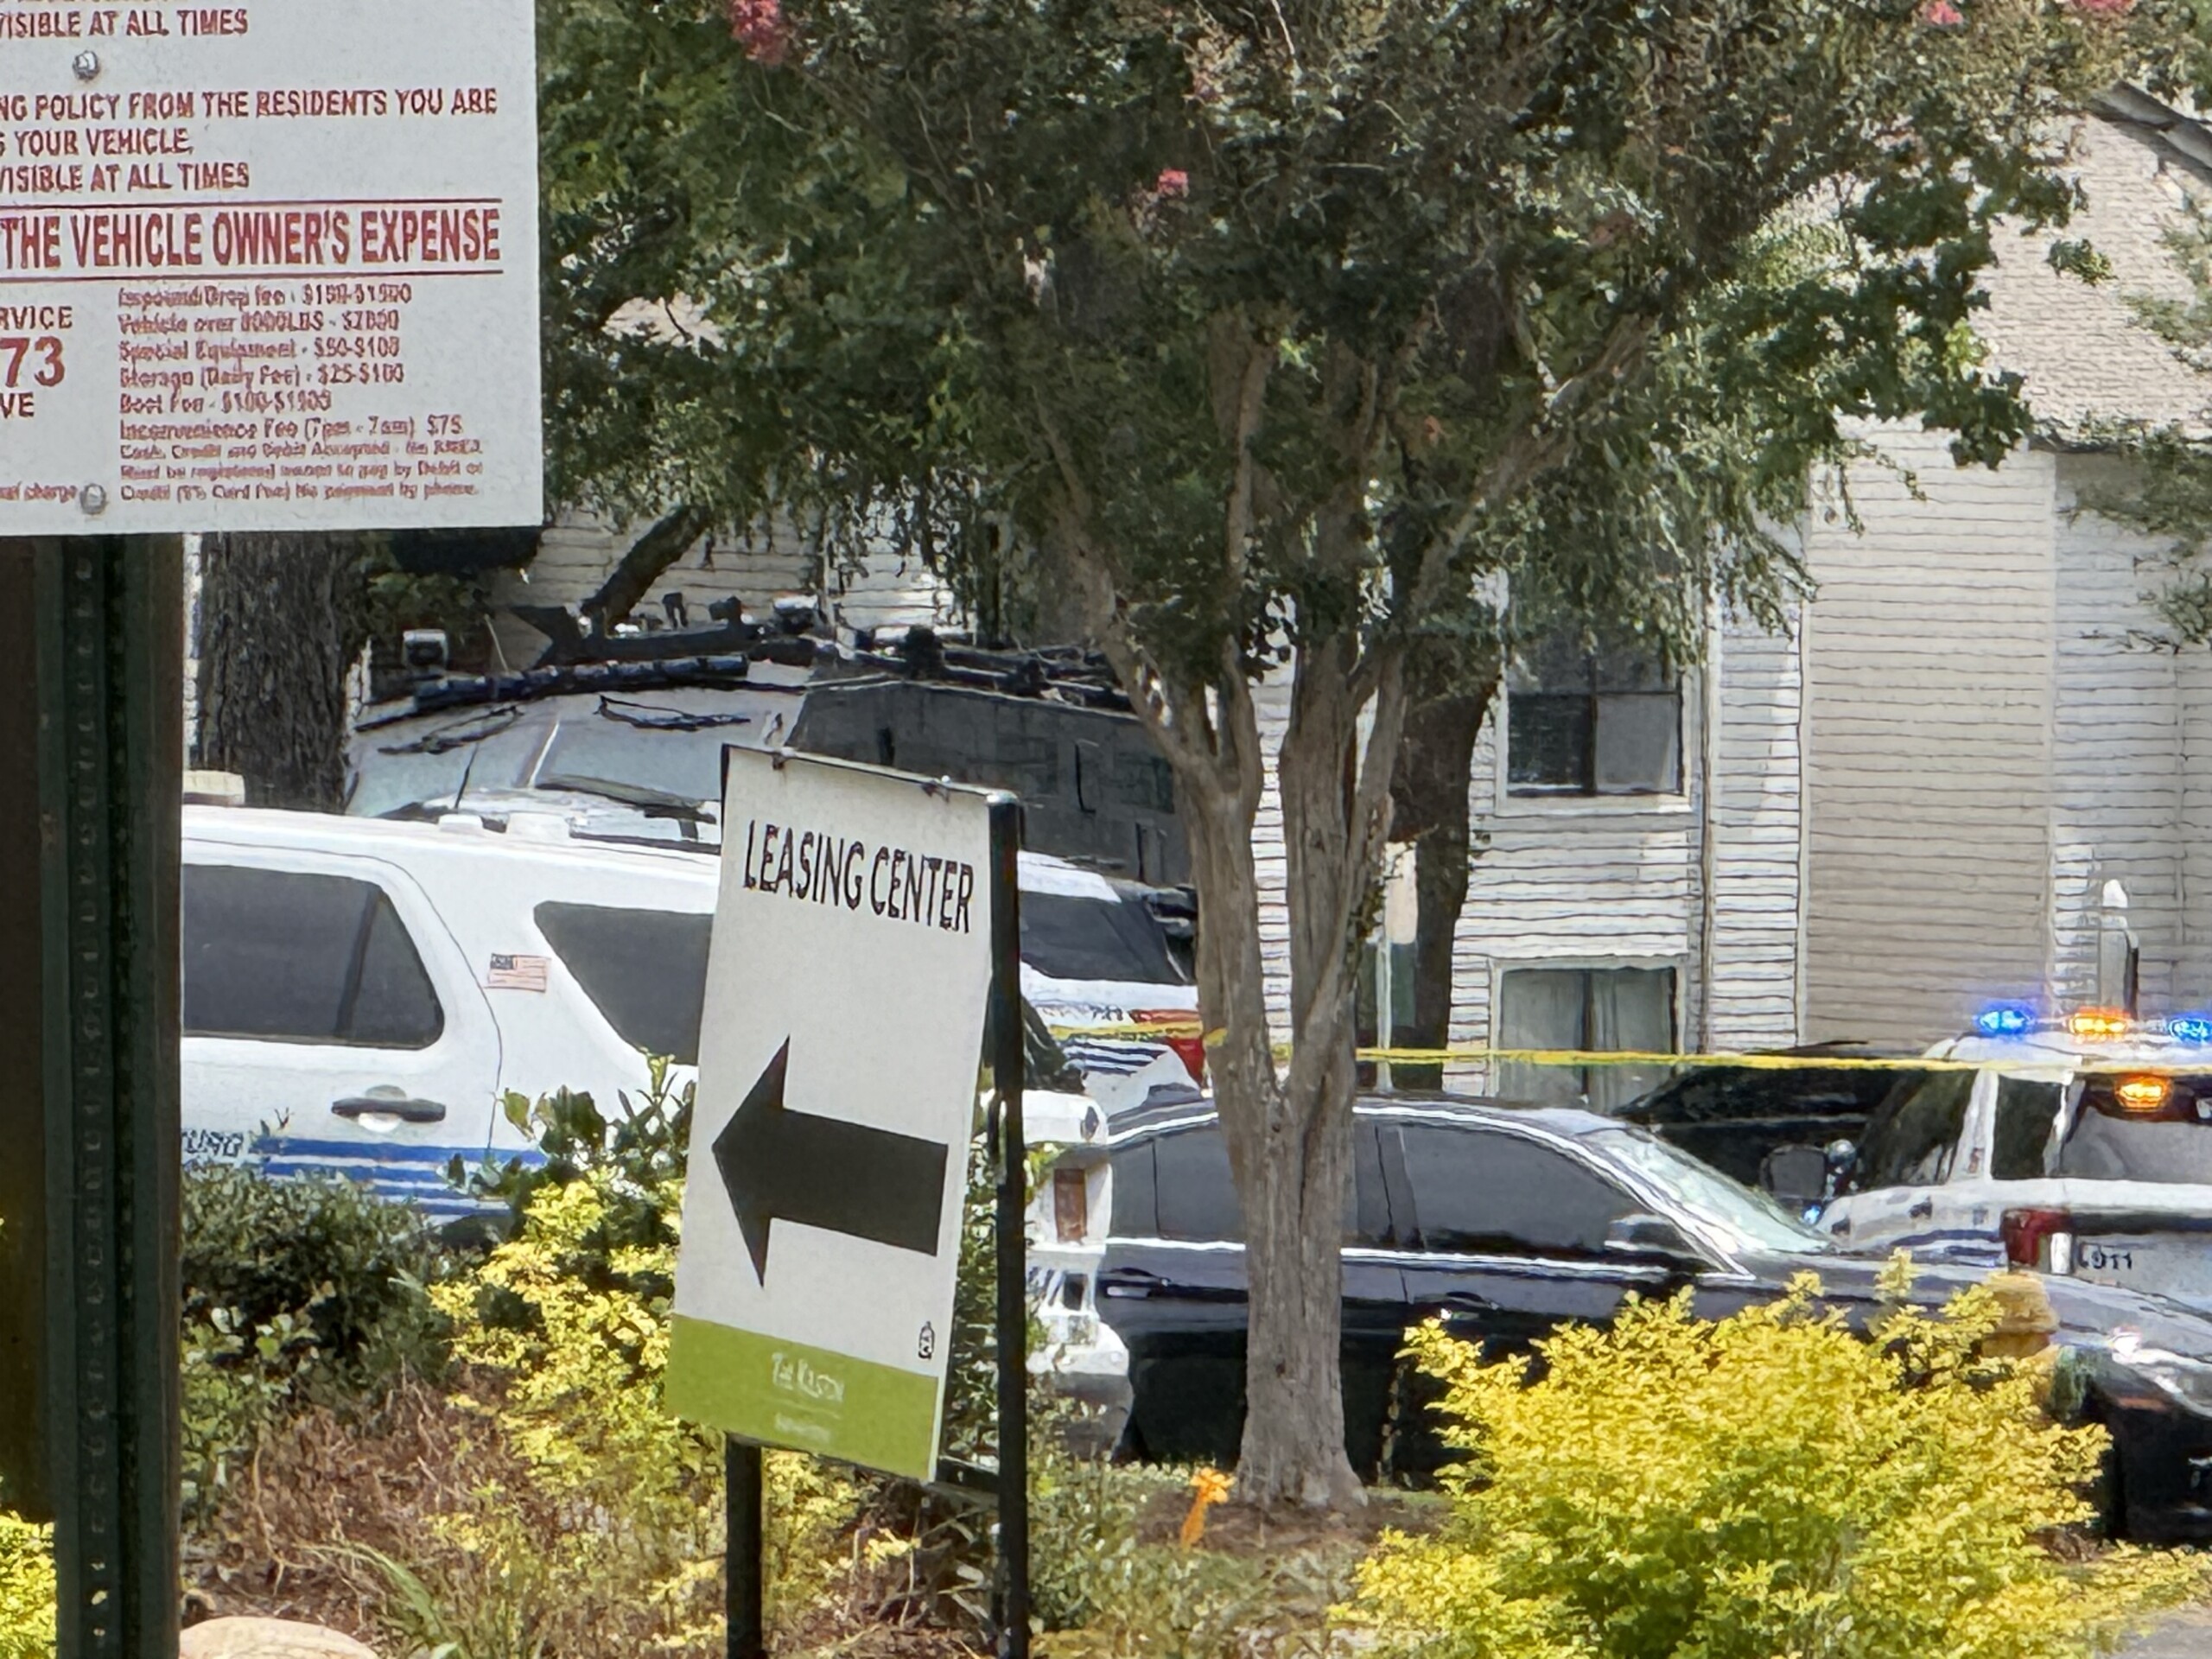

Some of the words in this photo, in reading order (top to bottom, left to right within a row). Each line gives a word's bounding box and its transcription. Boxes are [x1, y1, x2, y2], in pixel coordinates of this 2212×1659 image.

[89, 10, 119, 36] AT
[126, 10, 170, 36] ALL
[177, 9, 249, 36] TIMES
[35, 93, 120, 121] POLICY
[130, 92, 194, 120] FROM
[201, 91, 250, 118] THE
[257, 89, 388, 118] RESIDENTS
[395, 88, 443, 116] YOU
[451, 88, 498, 115] ARE
[14, 129, 79, 157] YOUR
[91, 163, 121, 192] AT
[128, 162, 173, 192] ALL
[177, 162, 250, 190] TIMES
[0, 216, 61, 269] THE
[70, 213, 203, 267] VEHICLE
[213, 210, 349, 266] OWNER'S
[361, 208, 501, 264] EXPENSE
[0, 335, 65, 387] 73
[742, 819, 865, 912] LEASING
[869, 845, 974, 934] CENTER
